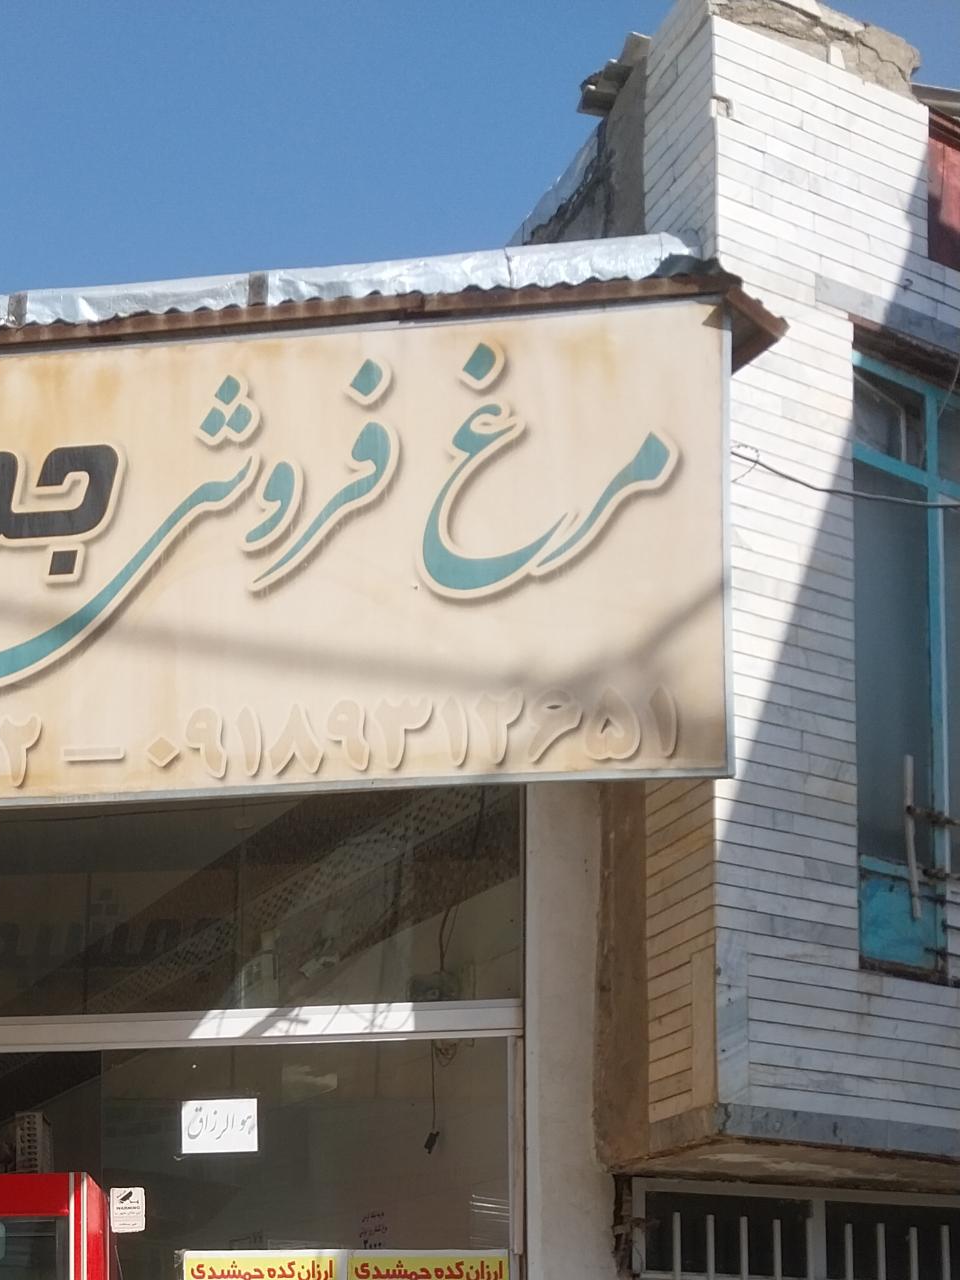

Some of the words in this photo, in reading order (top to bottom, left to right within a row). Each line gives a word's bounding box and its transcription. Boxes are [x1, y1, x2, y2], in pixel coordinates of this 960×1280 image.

[421, 341, 676, 592] مرغ
[267, 1261, 295, 1278] کده
[434, 1261, 464, 1279] کده
